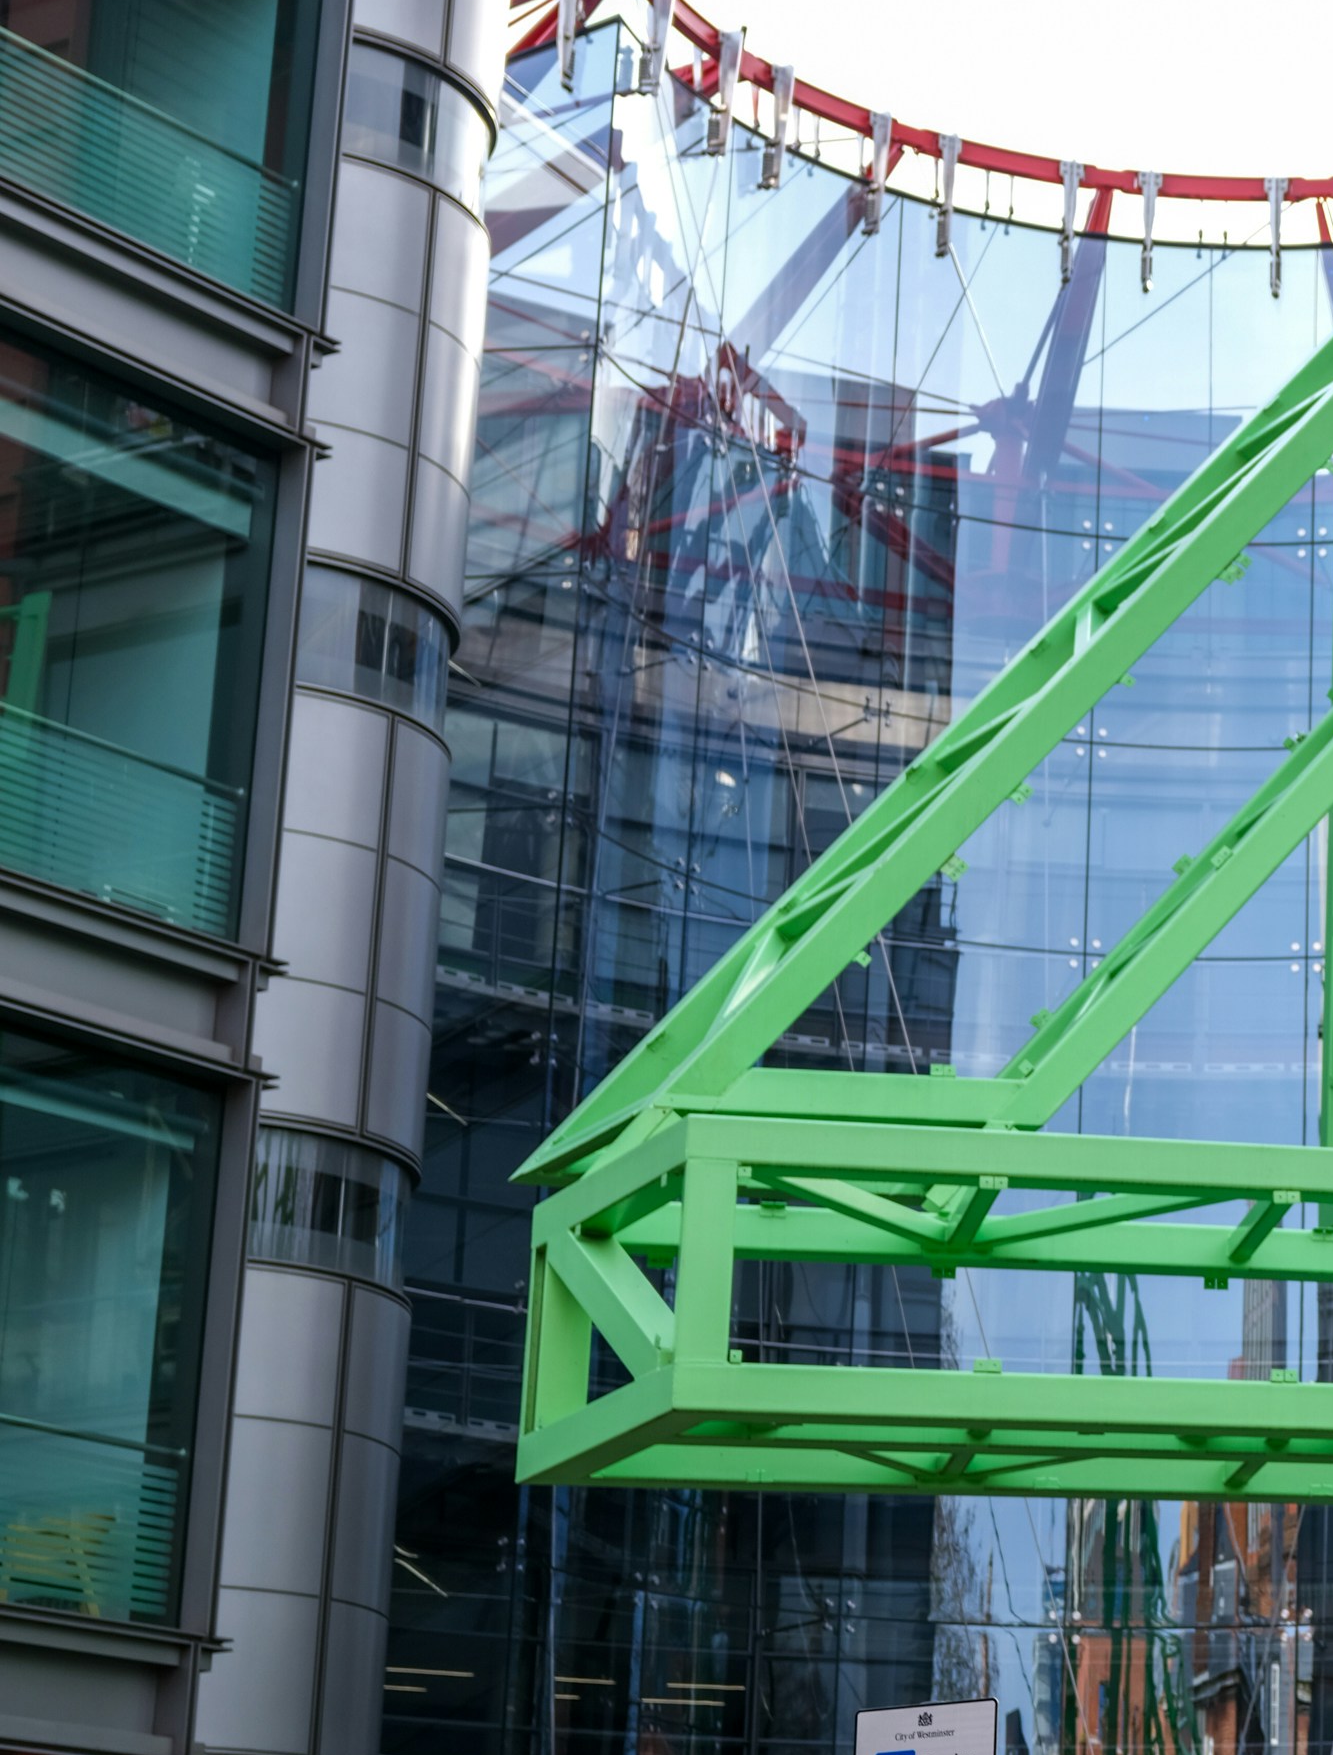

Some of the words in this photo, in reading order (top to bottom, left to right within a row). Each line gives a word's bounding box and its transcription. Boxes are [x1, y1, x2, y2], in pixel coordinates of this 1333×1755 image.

[895, 1732, 908, 1742] City
[908, 1731, 916, 1740] of
[916, 1729, 955, 1739] Westminster
